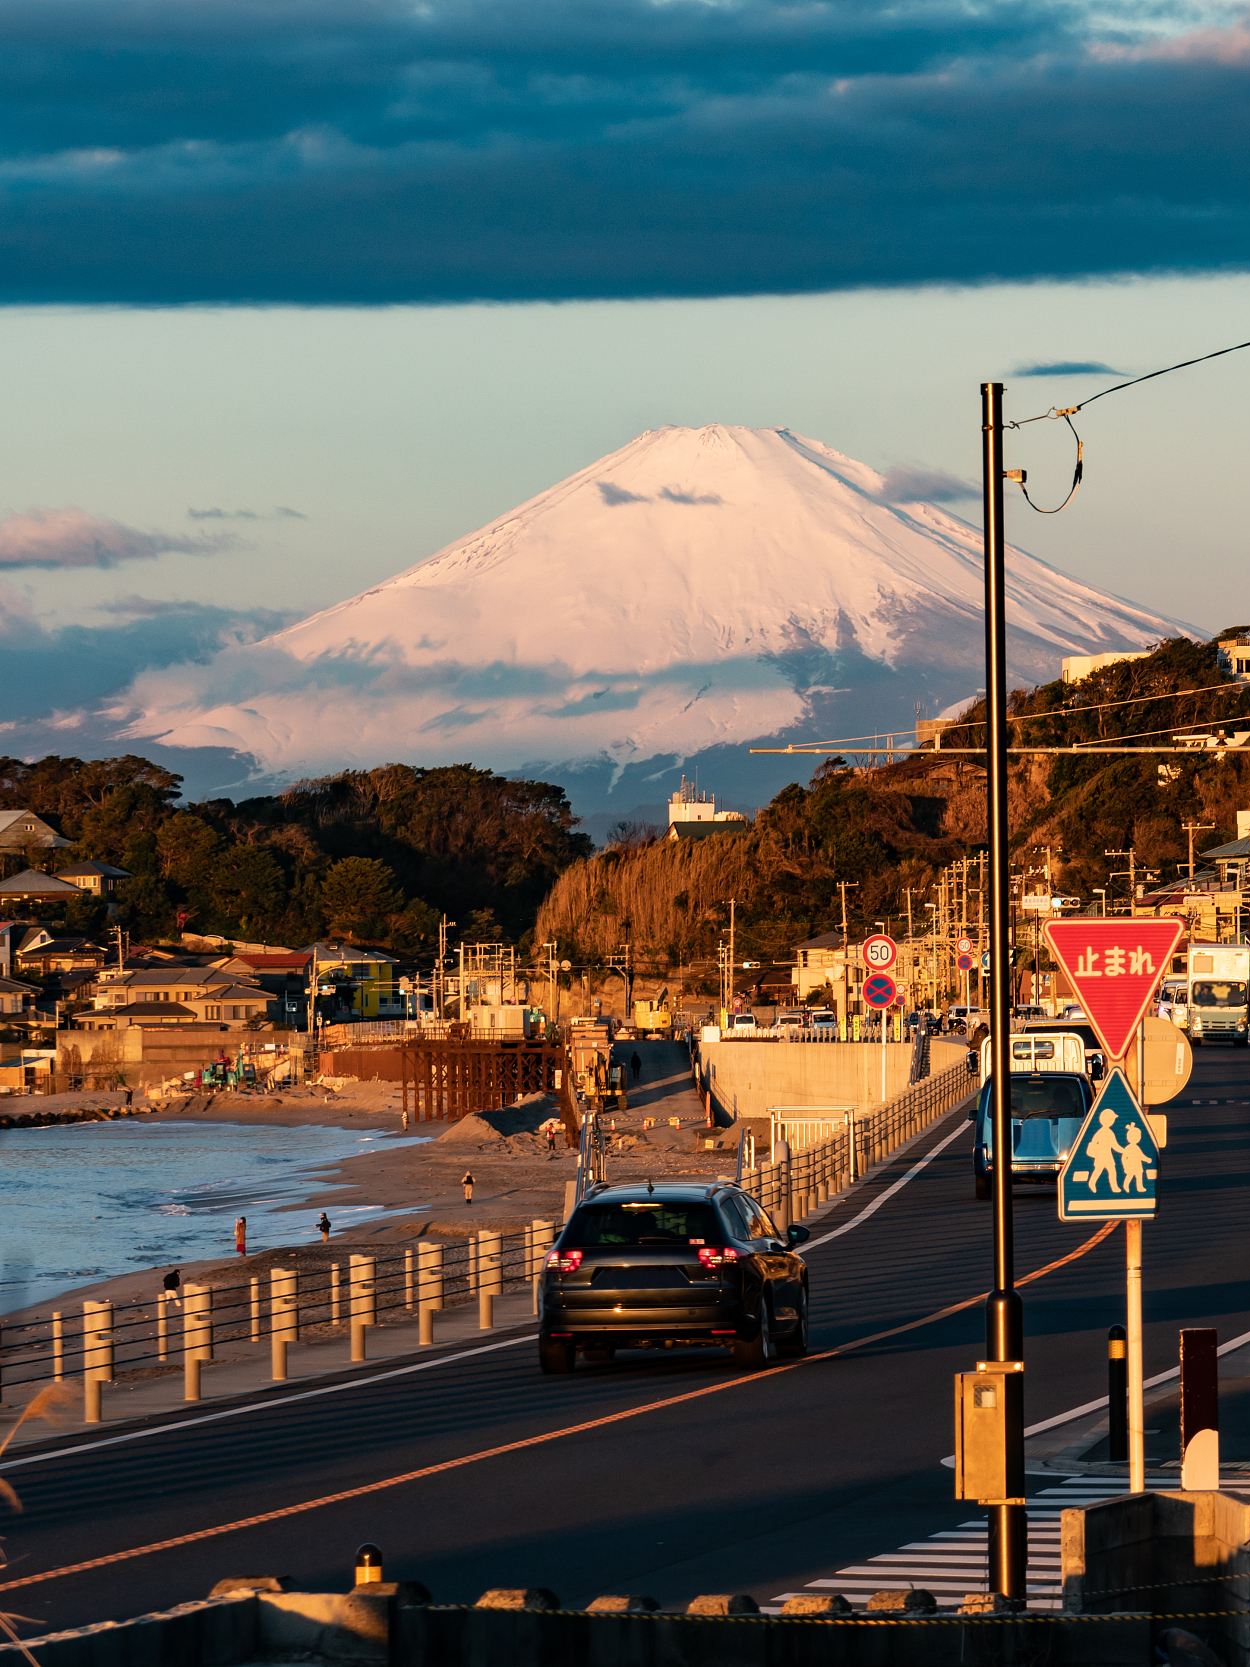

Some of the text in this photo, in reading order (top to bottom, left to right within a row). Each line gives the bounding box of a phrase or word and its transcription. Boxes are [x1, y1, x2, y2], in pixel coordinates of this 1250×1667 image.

[870, 945, 890, 961] 50
[1074, 945, 1156, 977] 止まれ
